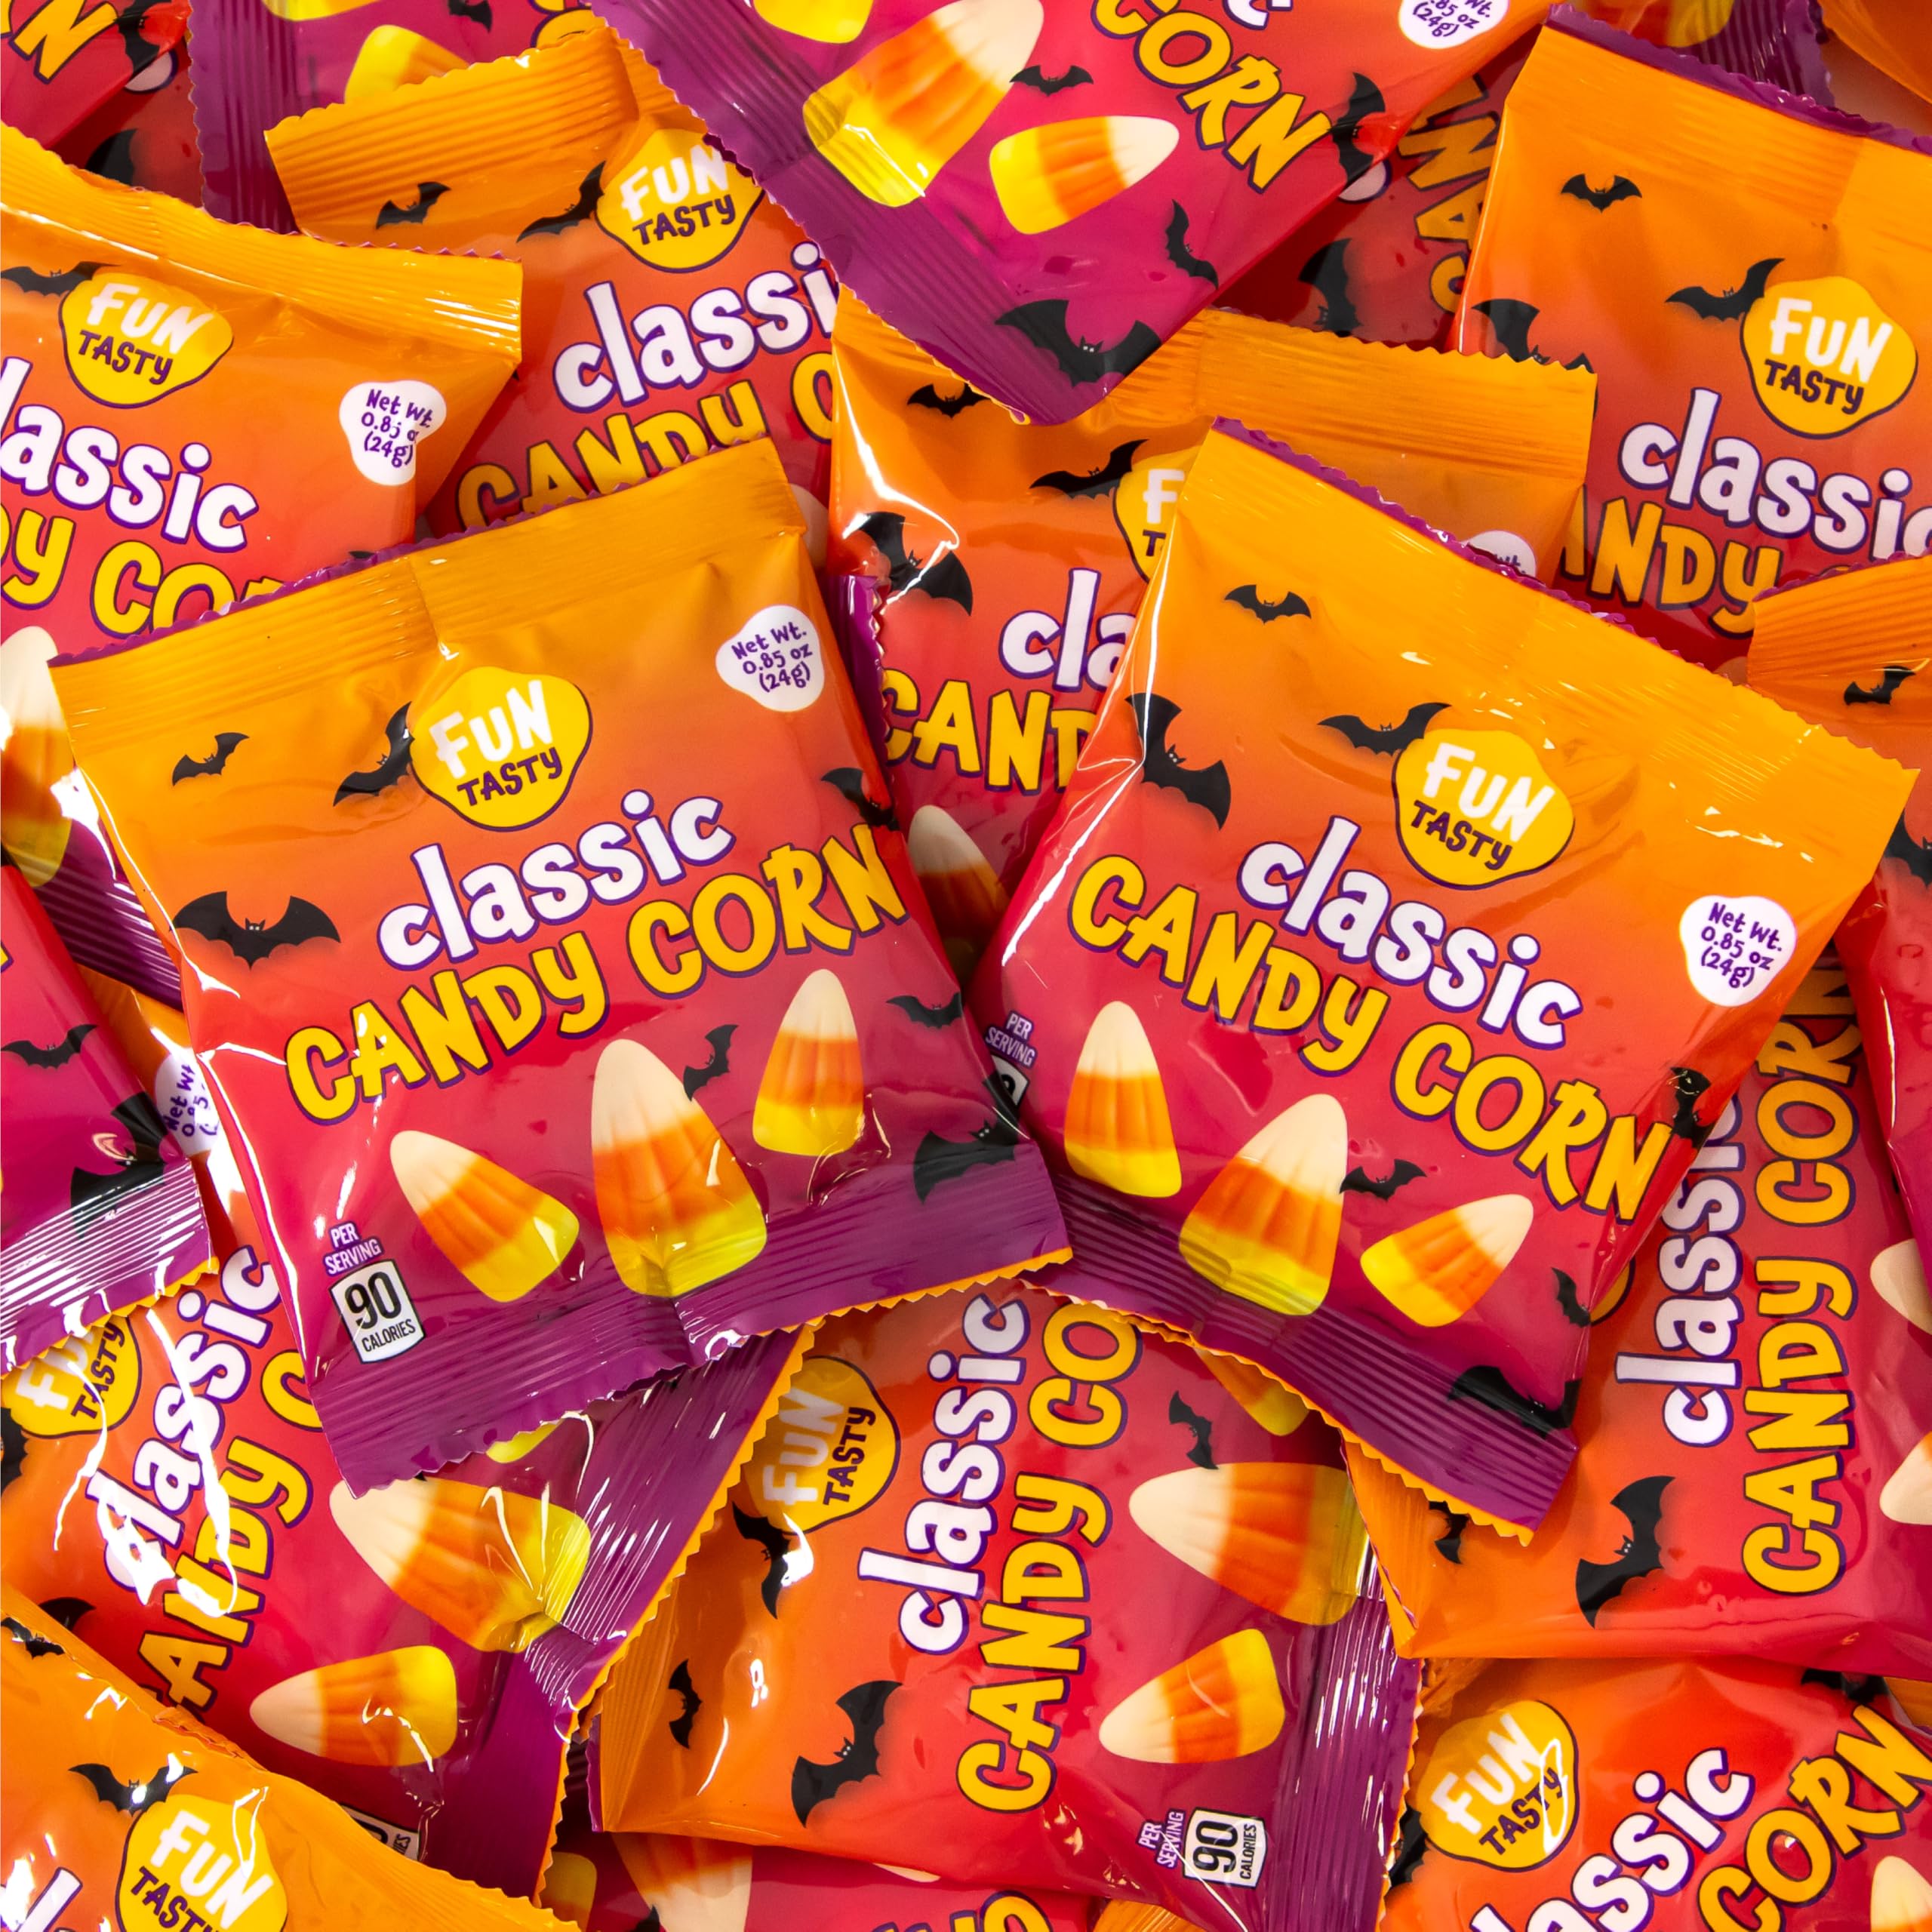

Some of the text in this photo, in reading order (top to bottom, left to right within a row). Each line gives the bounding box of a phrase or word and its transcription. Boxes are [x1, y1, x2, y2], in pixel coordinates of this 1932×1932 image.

[1413, 2, 1460, 37] (24g)
[1457, 14, 1479, 29] oz
[619, 144, 729, 222] FUN
[632, 194, 736, 245] TASTY
[86, 282, 214, 355] FUN
[552, 242, 839, 413] classi
[1769, 297, 1893, 383] FUN
[78, 329, 174, 386] TASTY
[1764, 358, 1864, 415] TASTY
[366, 389, 401, 415] Net
[0, 356, 259, 553] assic
[364, 431, 414, 468] (24g)
[90, 540, 287, 640] CO
[1562, 483, 1784, 638] NDY
[731, 622, 807, 660] Net Wt.
[743, 644, 813, 675] 0.85 oz
[759, 661, 811, 693] (24g)
[428, 679, 553, 780] FUN
[883, 668, 1097, 800] CAND
[457, 746, 562, 807] TASTY
[1423, 742, 1555, 843] FUN
[1411, 799, 1512, 870] TASTY
[377, 789, 737, 971] classic
[1237, 815, 1583, 1051] classic
[1701, 926, 1774, 971] 0.85 oz
[1709, 902, 1782, 951] Net Wt.
[285, 823, 910, 1125] CANDY CORN
[1701, 946, 1755, 989] (24g)
[985, 1026, 1035, 1066] SERVING
[1006, 1013, 1032, 1040] PER
[1068, 854, 1675, 1224] CANDY CORN
[325, 1238, 382, 1275] SERVING
[331, 1223, 359, 1247] PER
[1614, 1093, 1746, 1447] classi
[344, 1272, 401, 1330] 90
[361, 1318, 416, 1352] CALORIES
[15, 1332, 94, 1410] FU
[1028, 1301, 1143, 1450] CO
[762, 1386, 844, 1506] FUN
[823, 1407, 876, 1506] TASTY
[1742, 1256, 1858, 1596] CANDY
[857, 1293, 1031, 1655] classic
[138, 1436, 313, 1713] ANDY
[956, 1471, 1113, 1814] CANDY
[1431, 1712, 1544, 1835] FUN
[150, 1809, 274, 1930] FUN
[1138, 1822, 1161, 1849] PER
[1192, 1820, 1238, 1873] 90
[1240, 1823, 1257, 1879] CALORIES
[131, 1866, 220, 1932] TAST
